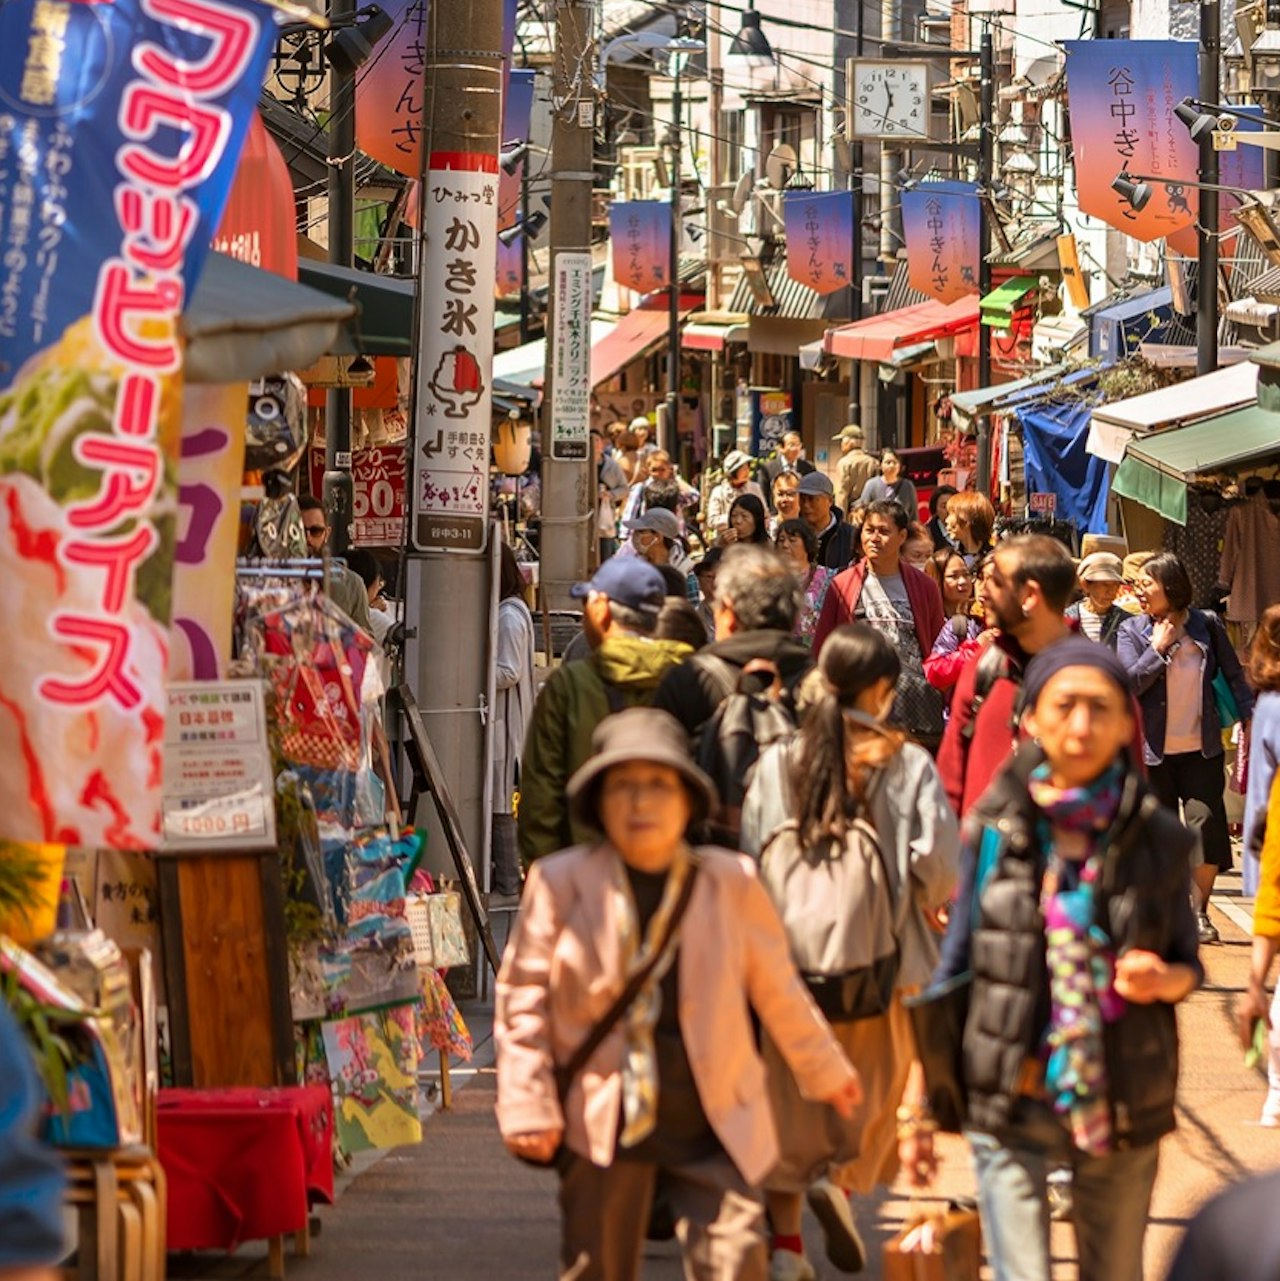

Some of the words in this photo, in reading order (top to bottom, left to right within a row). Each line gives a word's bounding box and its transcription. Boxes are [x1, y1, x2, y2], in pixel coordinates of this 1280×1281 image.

[1108, 66, 1140, 220] 谷中ぎ
[431, 183, 495, 206] ひみつ堂
[803, 204, 824, 285] 谷中ぎんざ
[926, 196, 948, 293] 谷中ぎんざ
[440, 216, 480, 337] かき氷
[447, 431, 486, 446] 手前曲る
[447, 445, 485, 461] すぐ先
[431, 527, 472, 539] 谷中3-11
